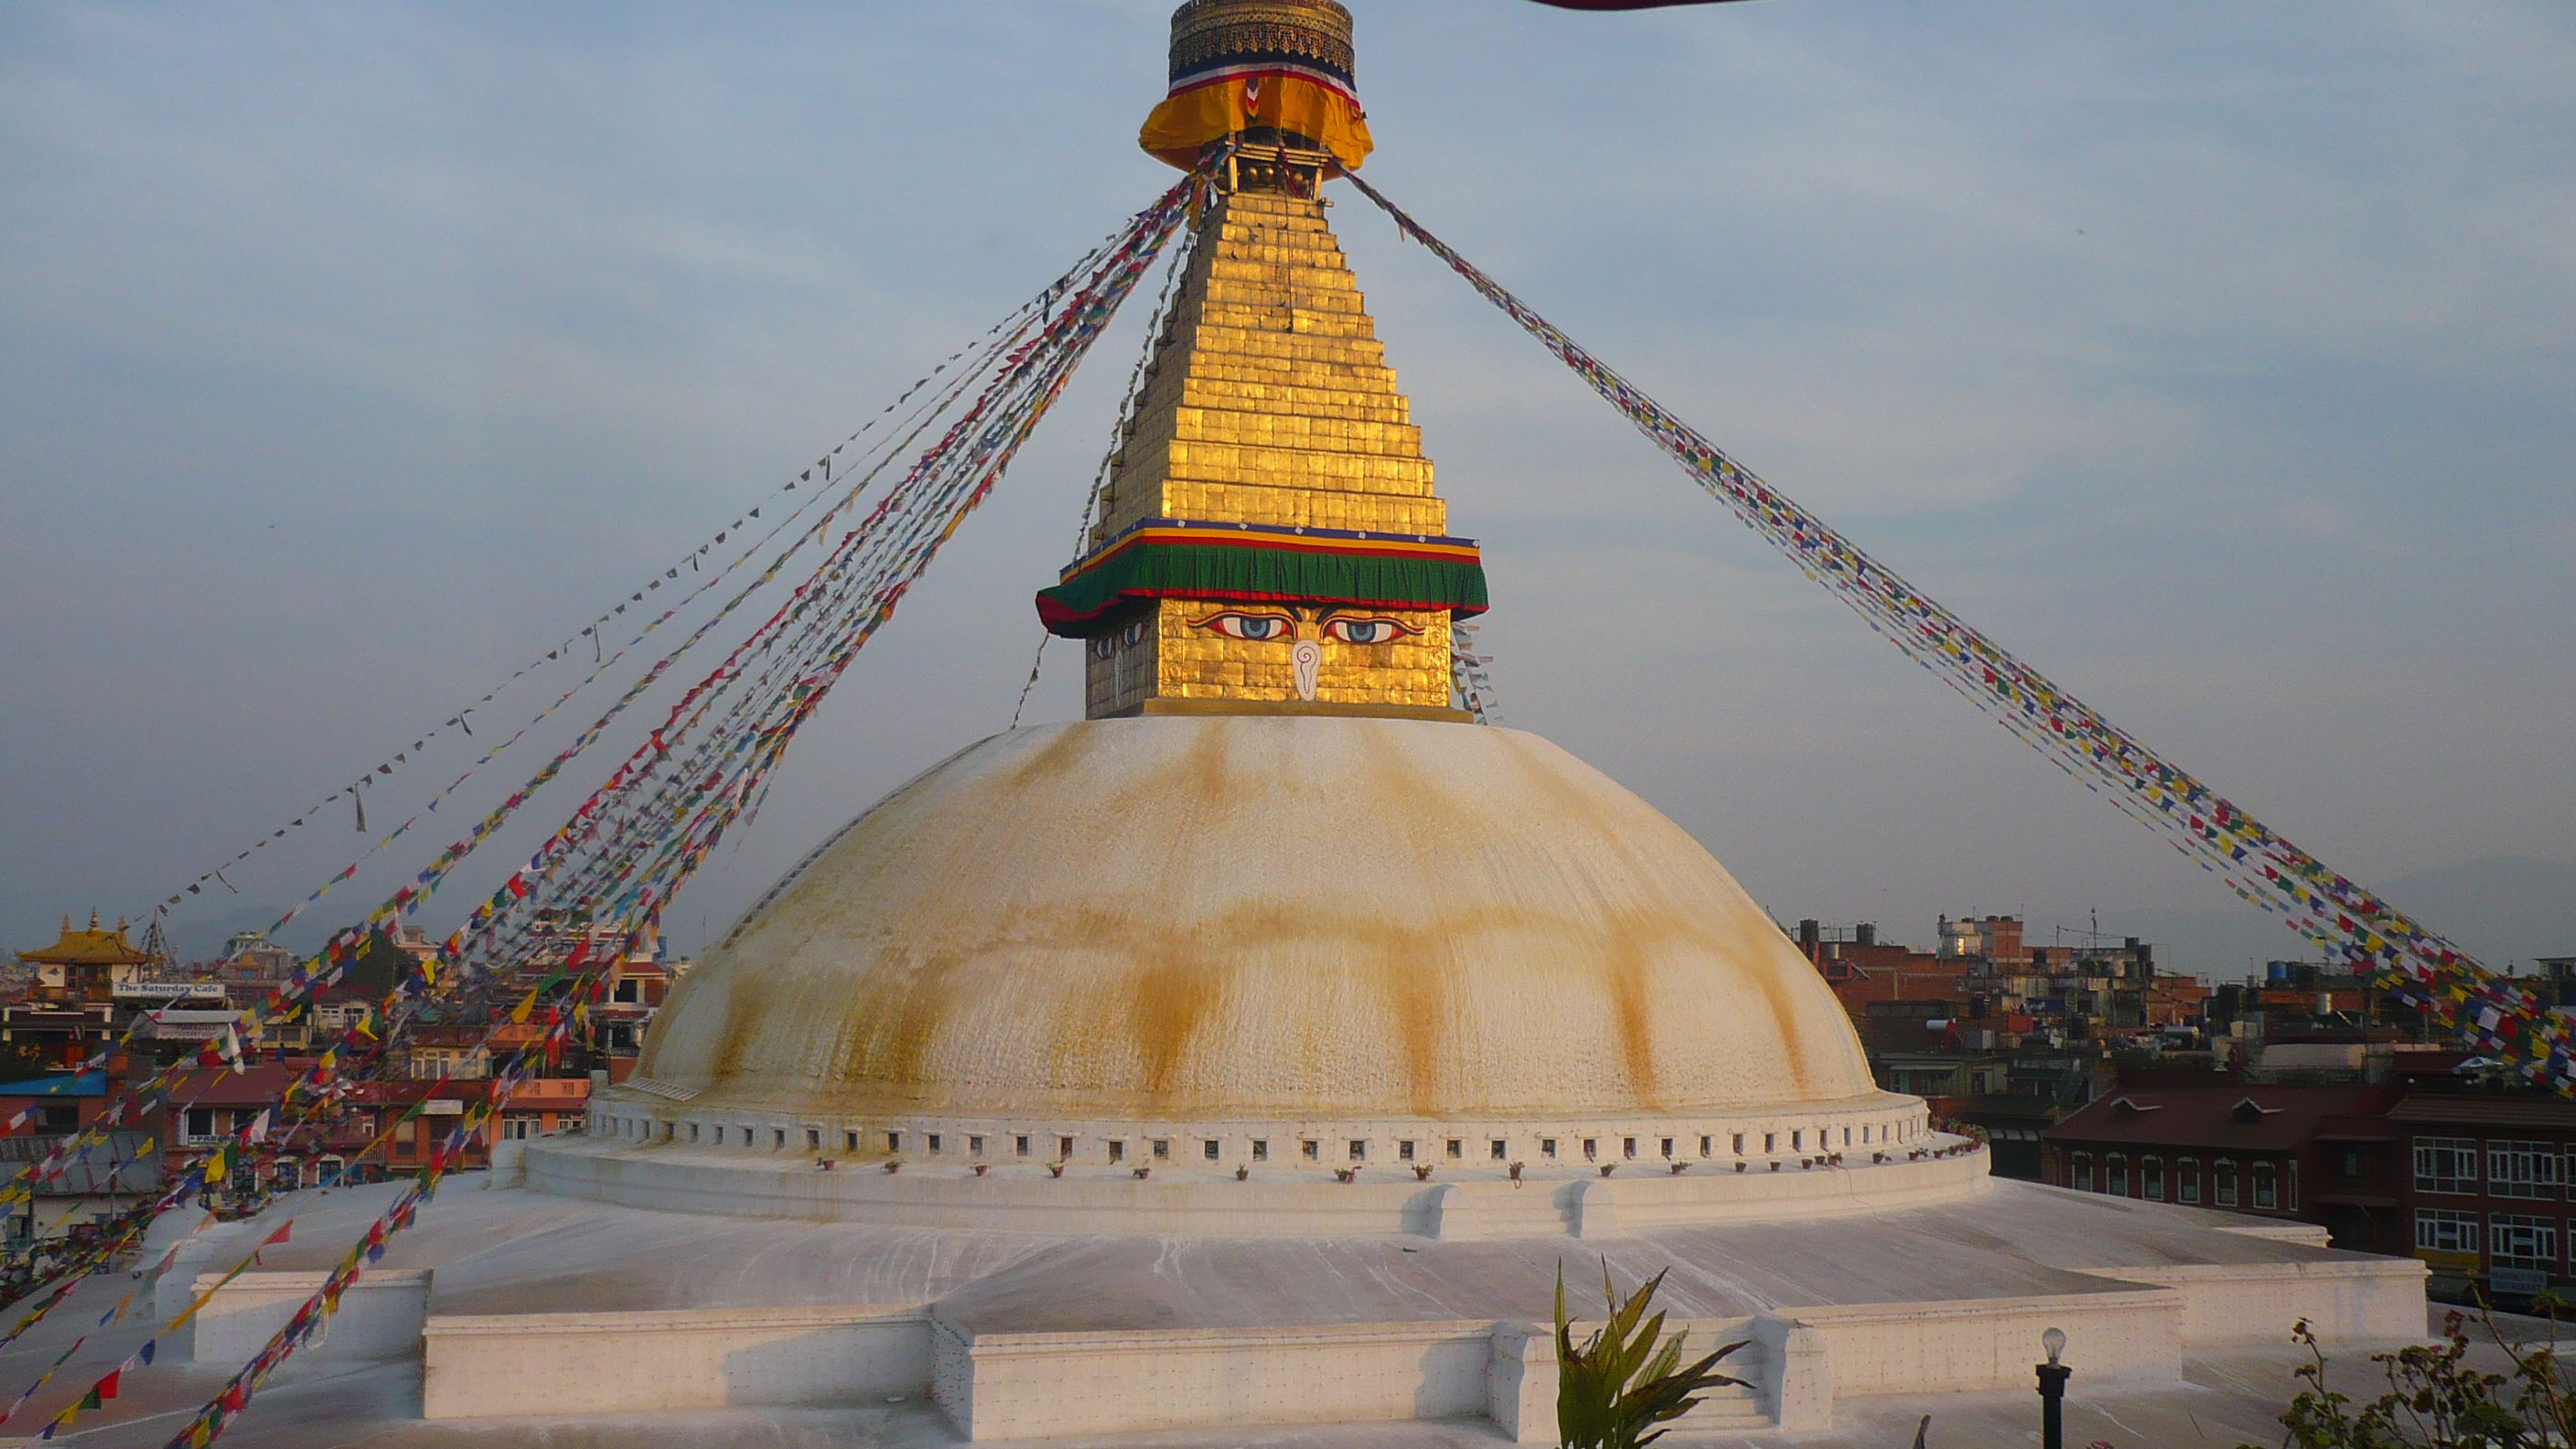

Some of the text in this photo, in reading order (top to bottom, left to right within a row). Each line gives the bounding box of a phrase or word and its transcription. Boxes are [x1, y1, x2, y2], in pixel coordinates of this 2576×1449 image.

[117, 983, 219, 993] The Saturday Cafe
